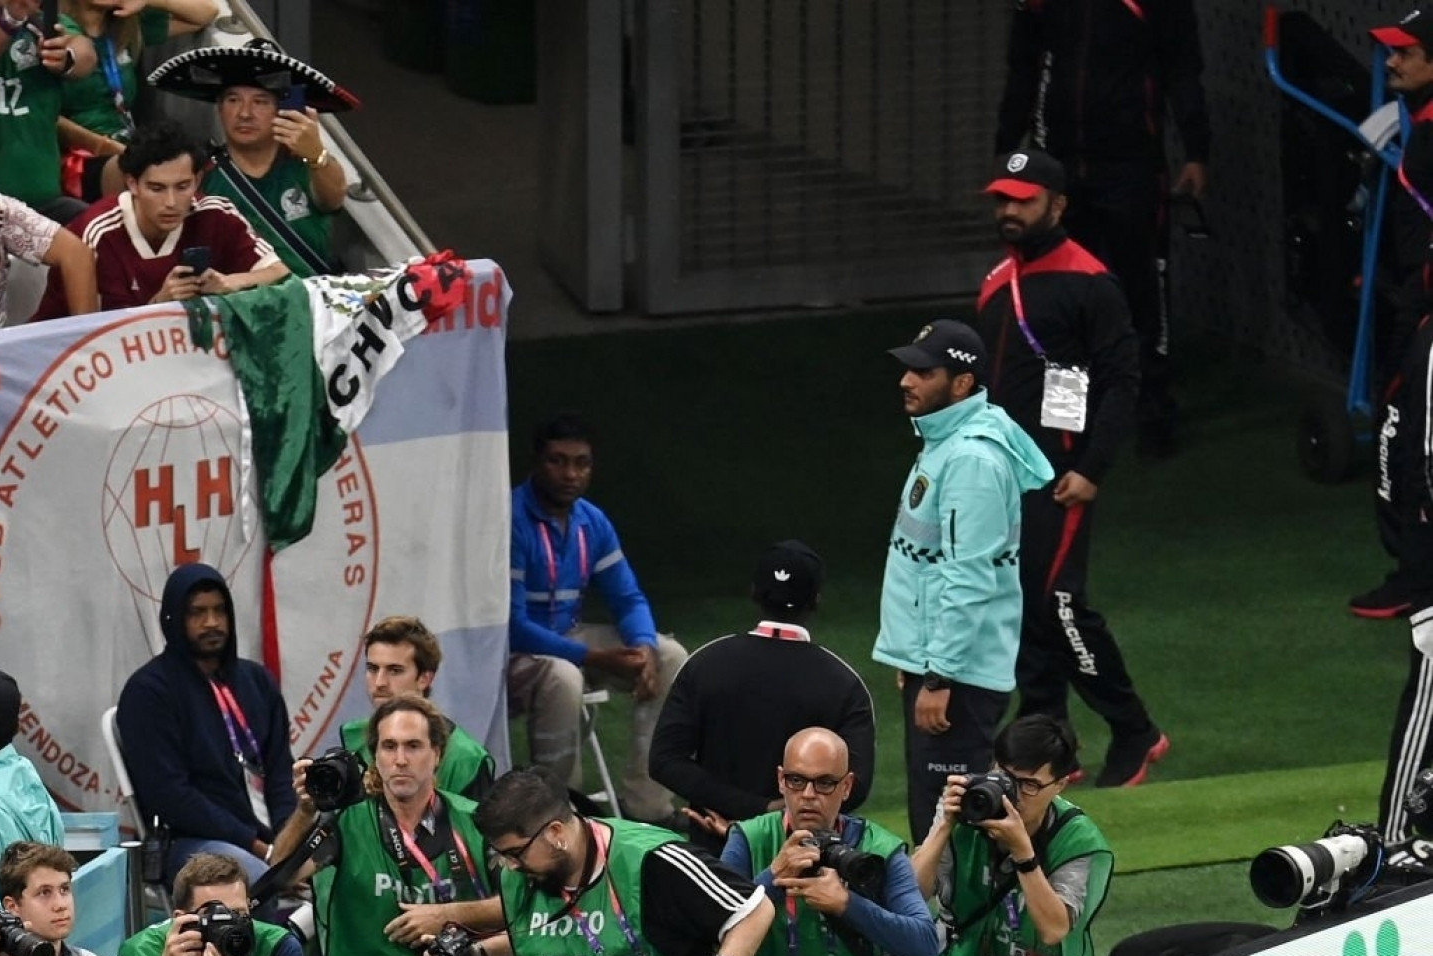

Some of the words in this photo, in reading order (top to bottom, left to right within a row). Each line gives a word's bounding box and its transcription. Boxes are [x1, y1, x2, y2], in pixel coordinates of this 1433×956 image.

[120, 326, 231, 366] HURC
[289, 649, 344, 745] ENTINA
[928, 763, 968, 772] POLICE
